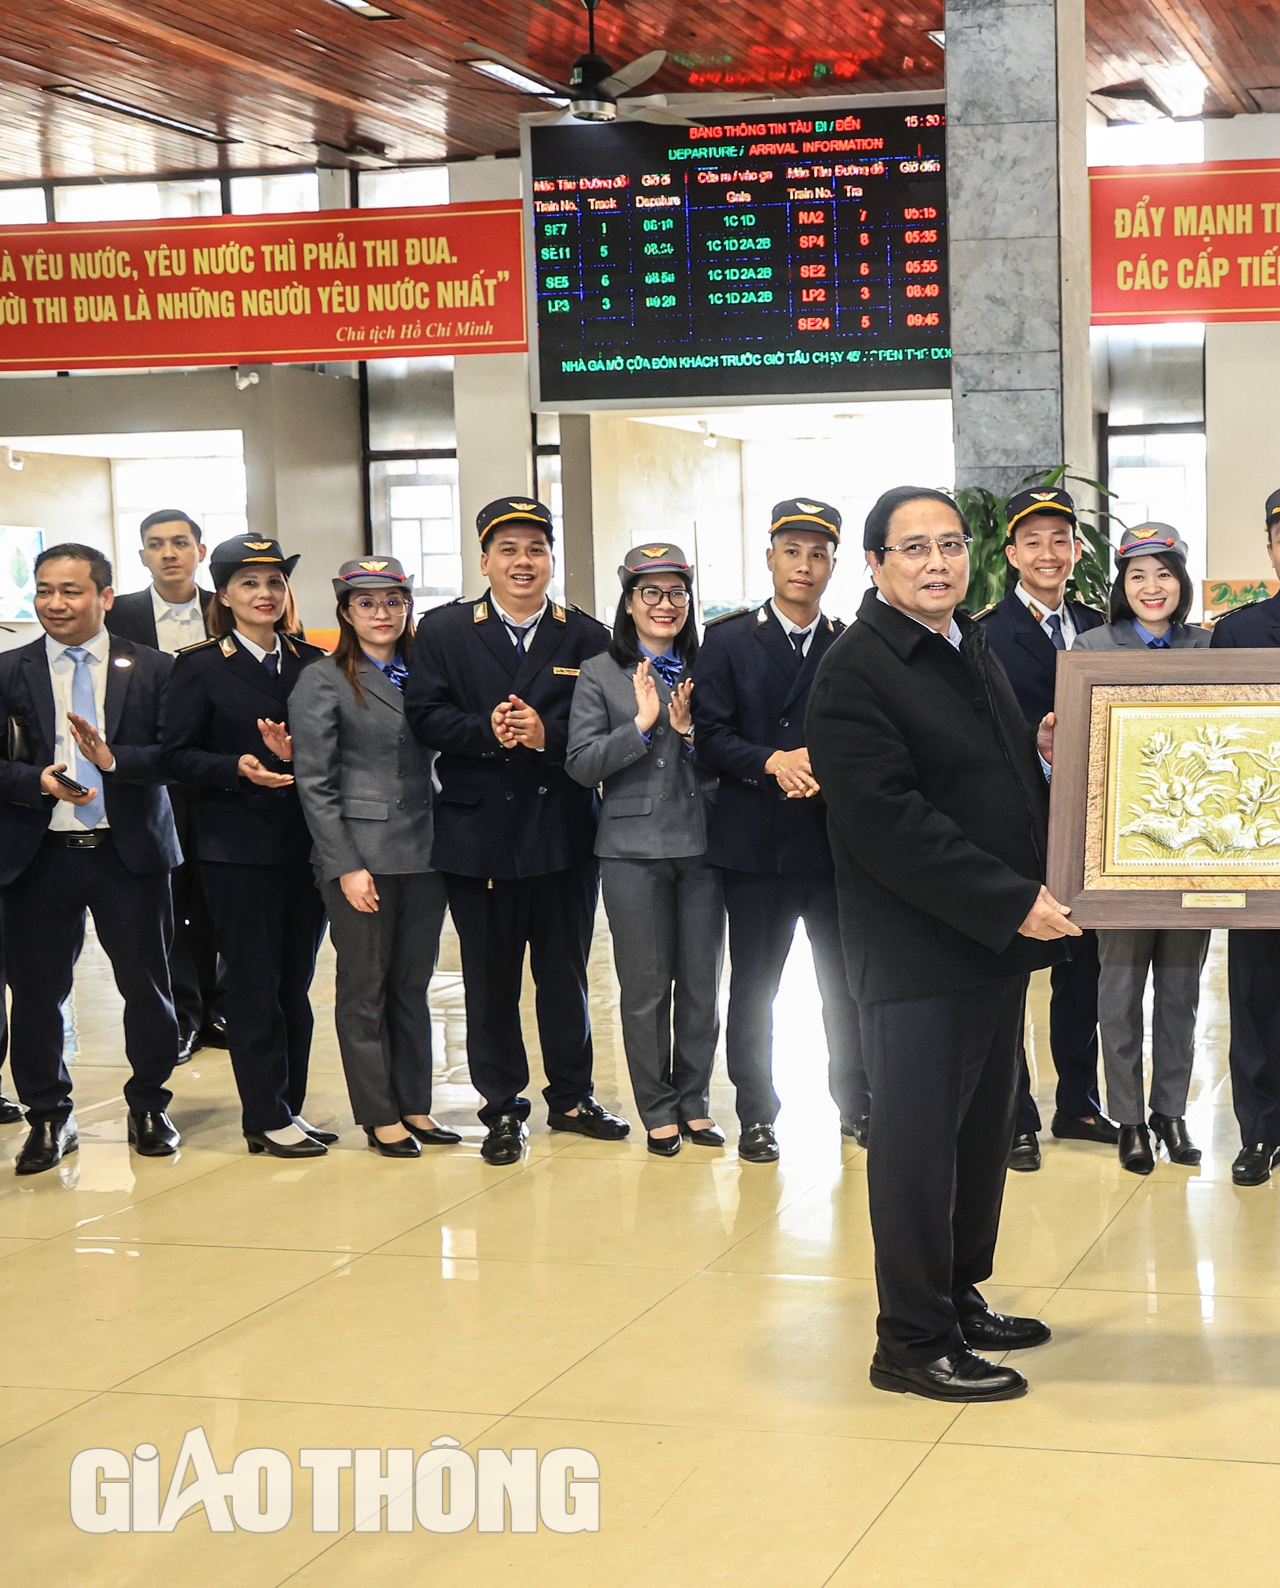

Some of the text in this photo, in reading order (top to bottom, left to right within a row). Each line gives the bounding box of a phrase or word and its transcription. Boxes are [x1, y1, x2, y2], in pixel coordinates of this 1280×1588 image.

[724, 123, 768, 137] THÔNG
[768, 122, 788, 135] TIN
[788, 119, 813, 134] TÀU
[835, 116, 861, 132] ĐẾN
[668, 145, 737, 160] DEPARTURE
[749, 141, 798, 156] ARRIVAL
[802, 138, 884, 154] INFORMATION
[787, 187, 814, 200] Train
[723, 215, 740, 227] 1C
[740, 214, 756, 227] 1D
[798, 210, 825, 224] NA2
[1114, 195, 1166, 238] ĐẨY
[1174, 203, 1253, 242] MẠNH
[21, 248, 64, 281] YÊU
[69, 246, 139, 281] NƯỚC,
[144, 243, 187, 277] YÊU
[193, 241, 255, 275] NƯỚC
[261, 238, 297, 272] THÌ
[303, 232, 357, 271] PHẢI
[363, 239, 399, 268] THI
[405, 236, 458, 266] ĐUA.
[540, 246, 571, 261] SE11
[600, 244, 609, 257] 5
[706, 239, 722, 252] 1C
[723, 238, 739, 251] 1D
[756, 237, 772, 250] 2B
[799, 235, 826, 249] SP4
[859, 232, 870, 246] 8
[904, 230, 938, 244] 05:35
[545, 275, 570, 289] SE5
[601, 274, 610, 287] 6
[707, 268, 723, 281] 1C
[724, 267, 740, 280] 1D
[756, 267, 772, 279] 2B
[800, 264, 826, 279] SE2
[859, 262, 870, 276] 6
[905, 260, 939, 274] 05:55
[1116, 254, 1169, 291] CÁC
[1177, 246, 1230, 289] CẤP
[33, 296, 68, 324] THI
[74, 295, 118, 323] ĐUA
[124, 288, 151, 321] LÀ
[157, 286, 235, 320] NHỮNG
[241, 281, 311, 317] NGƯỜI
[317, 280, 360, 314] YÊU
[367, 277, 430, 312] NƯỚC
[601, 297, 611, 310] 3
[708, 293, 723, 305] 1C
[725, 292, 740, 304] 1D
[757, 290, 773, 303] 2B
[802, 288, 826, 302] LP2
[860, 286, 871, 300] 3
[905, 283, 940, 298] 08:49
[335, 319, 494, 344] Chủ tịch Hồ Chí Minh
[797, 312, 940, 331] SE24 5 09:45
[562, 357, 587, 373] NHÀ
[679, 354, 719, 368] KHÁCH
